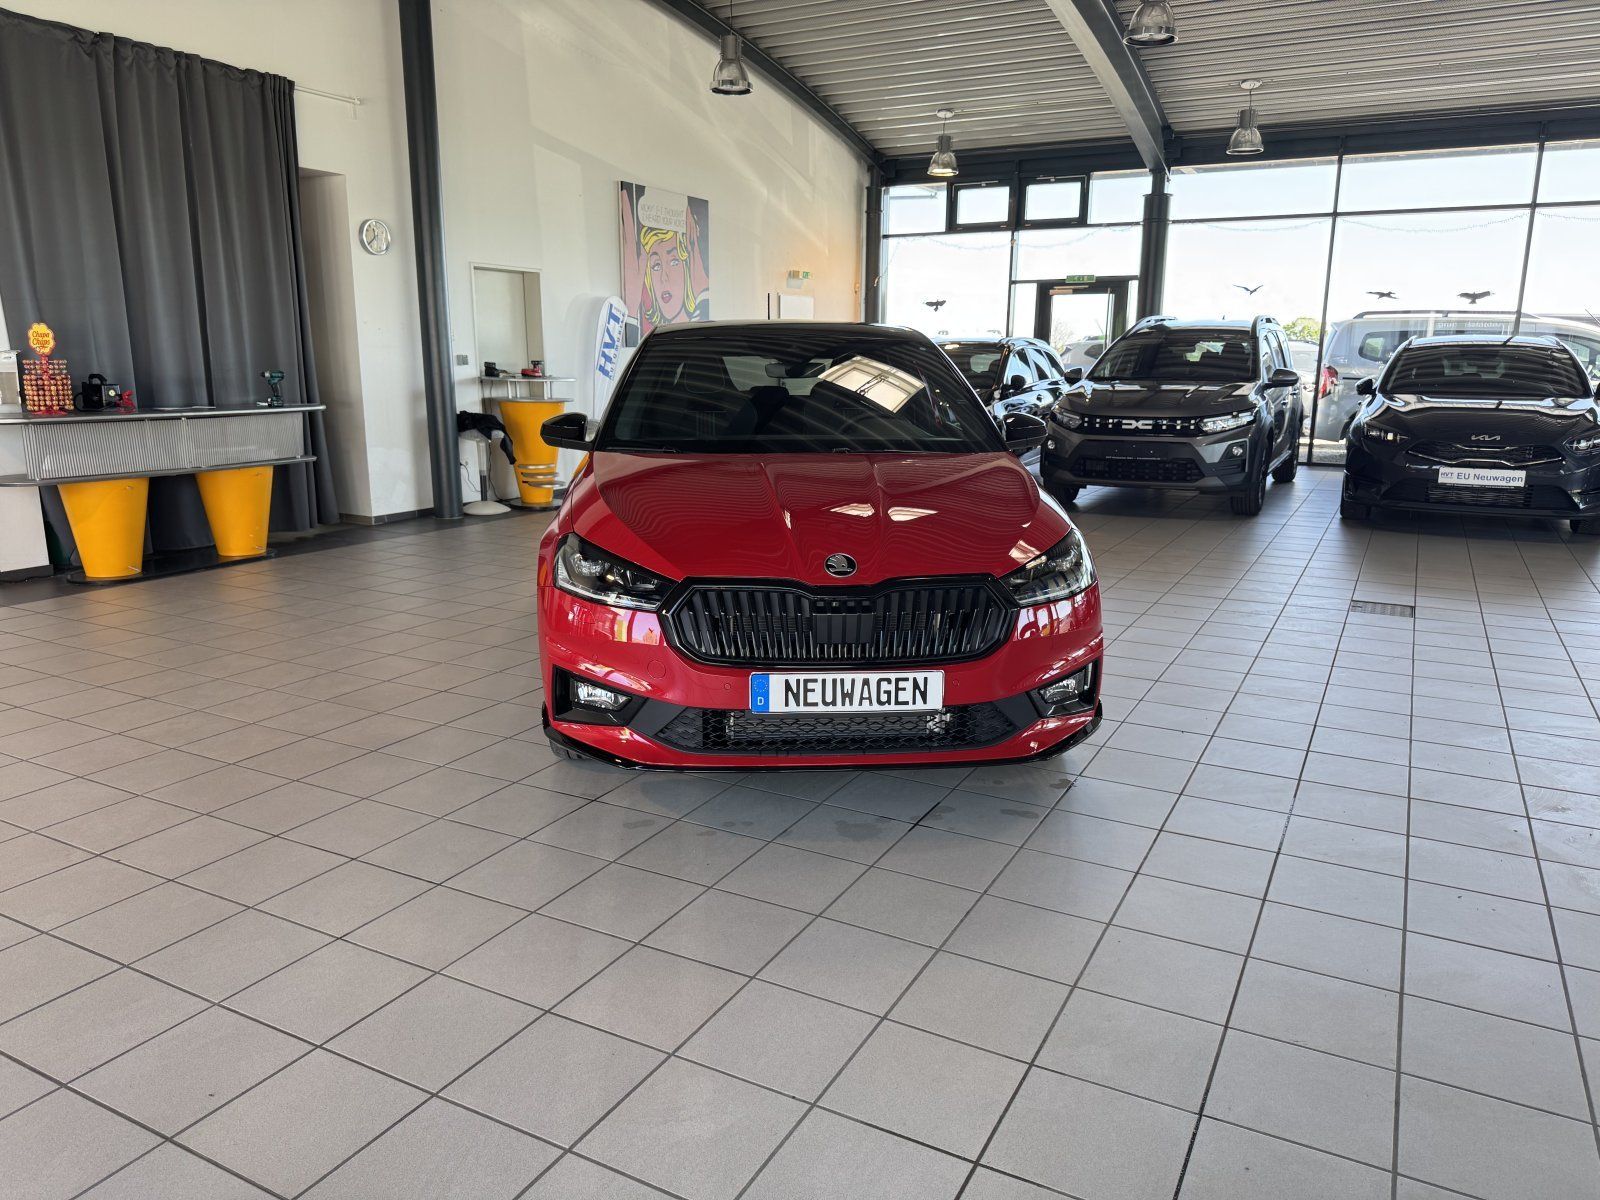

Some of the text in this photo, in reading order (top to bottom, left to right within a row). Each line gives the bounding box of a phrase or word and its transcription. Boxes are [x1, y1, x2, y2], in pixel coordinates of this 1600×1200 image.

[32, 330, 50, 338] Chupa
[598, 303, 620, 377] HVT
[1456, 472, 1471, 480] EU
[1473, 473, 1524, 484] Neuwagen
[757, 676, 929, 707] D NEUWAGEN
